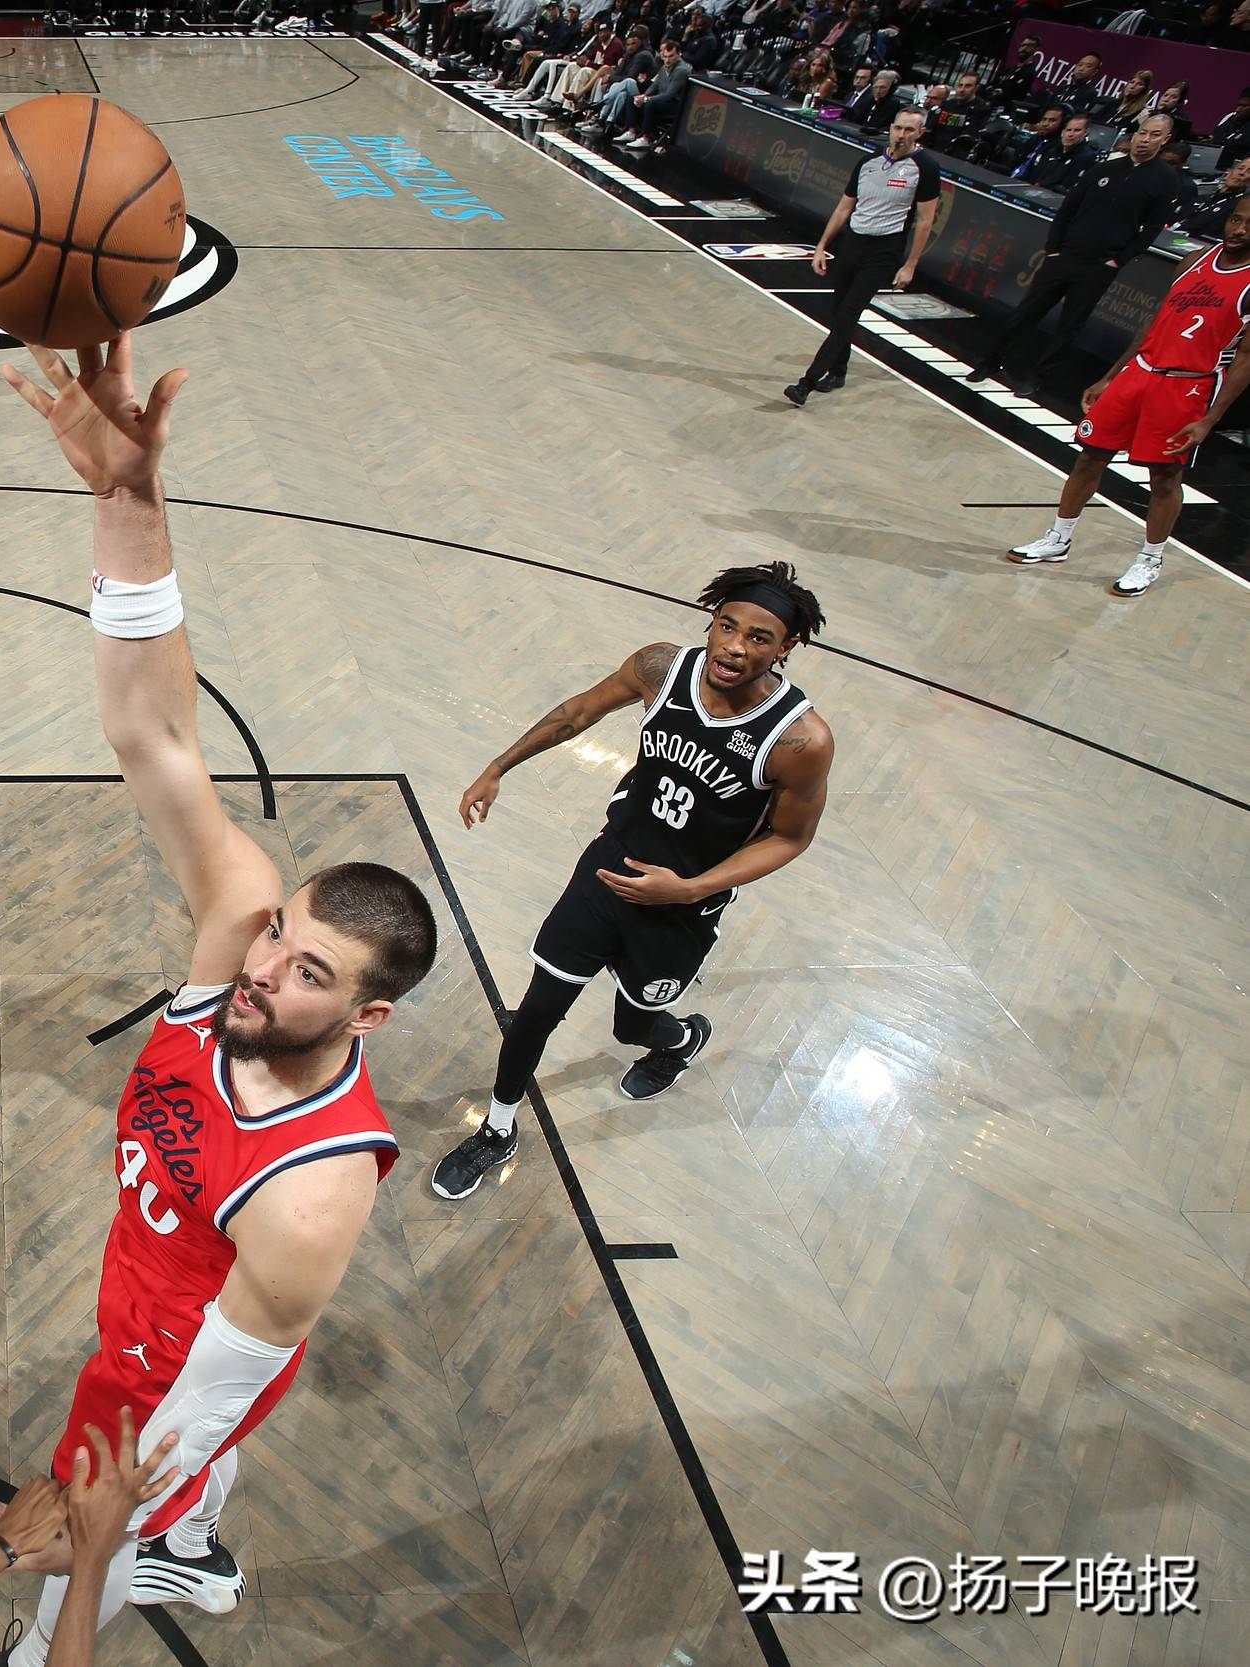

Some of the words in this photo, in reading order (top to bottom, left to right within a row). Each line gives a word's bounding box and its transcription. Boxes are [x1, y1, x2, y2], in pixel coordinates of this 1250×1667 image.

[1033, 51, 1077, 86] ATA
[282, 134, 395, 199] CENTER
[347, 135, 505, 221] BARCLAYS
[1169, 292, 1227, 313] Angeles
[1186, 280, 1214, 296] Los
[1180, 314, 1204, 339] 2
[726, 741, 755, 760] GUIDE
[731, 735, 757, 752] YOUR
[733, 729, 753, 742] GET
[642, 730, 748, 800] BROOKLYN
[651, 775, 695, 830] 33
[152, 1073, 204, 1143] Los
[131, 1064, 204, 1206] Angeles
